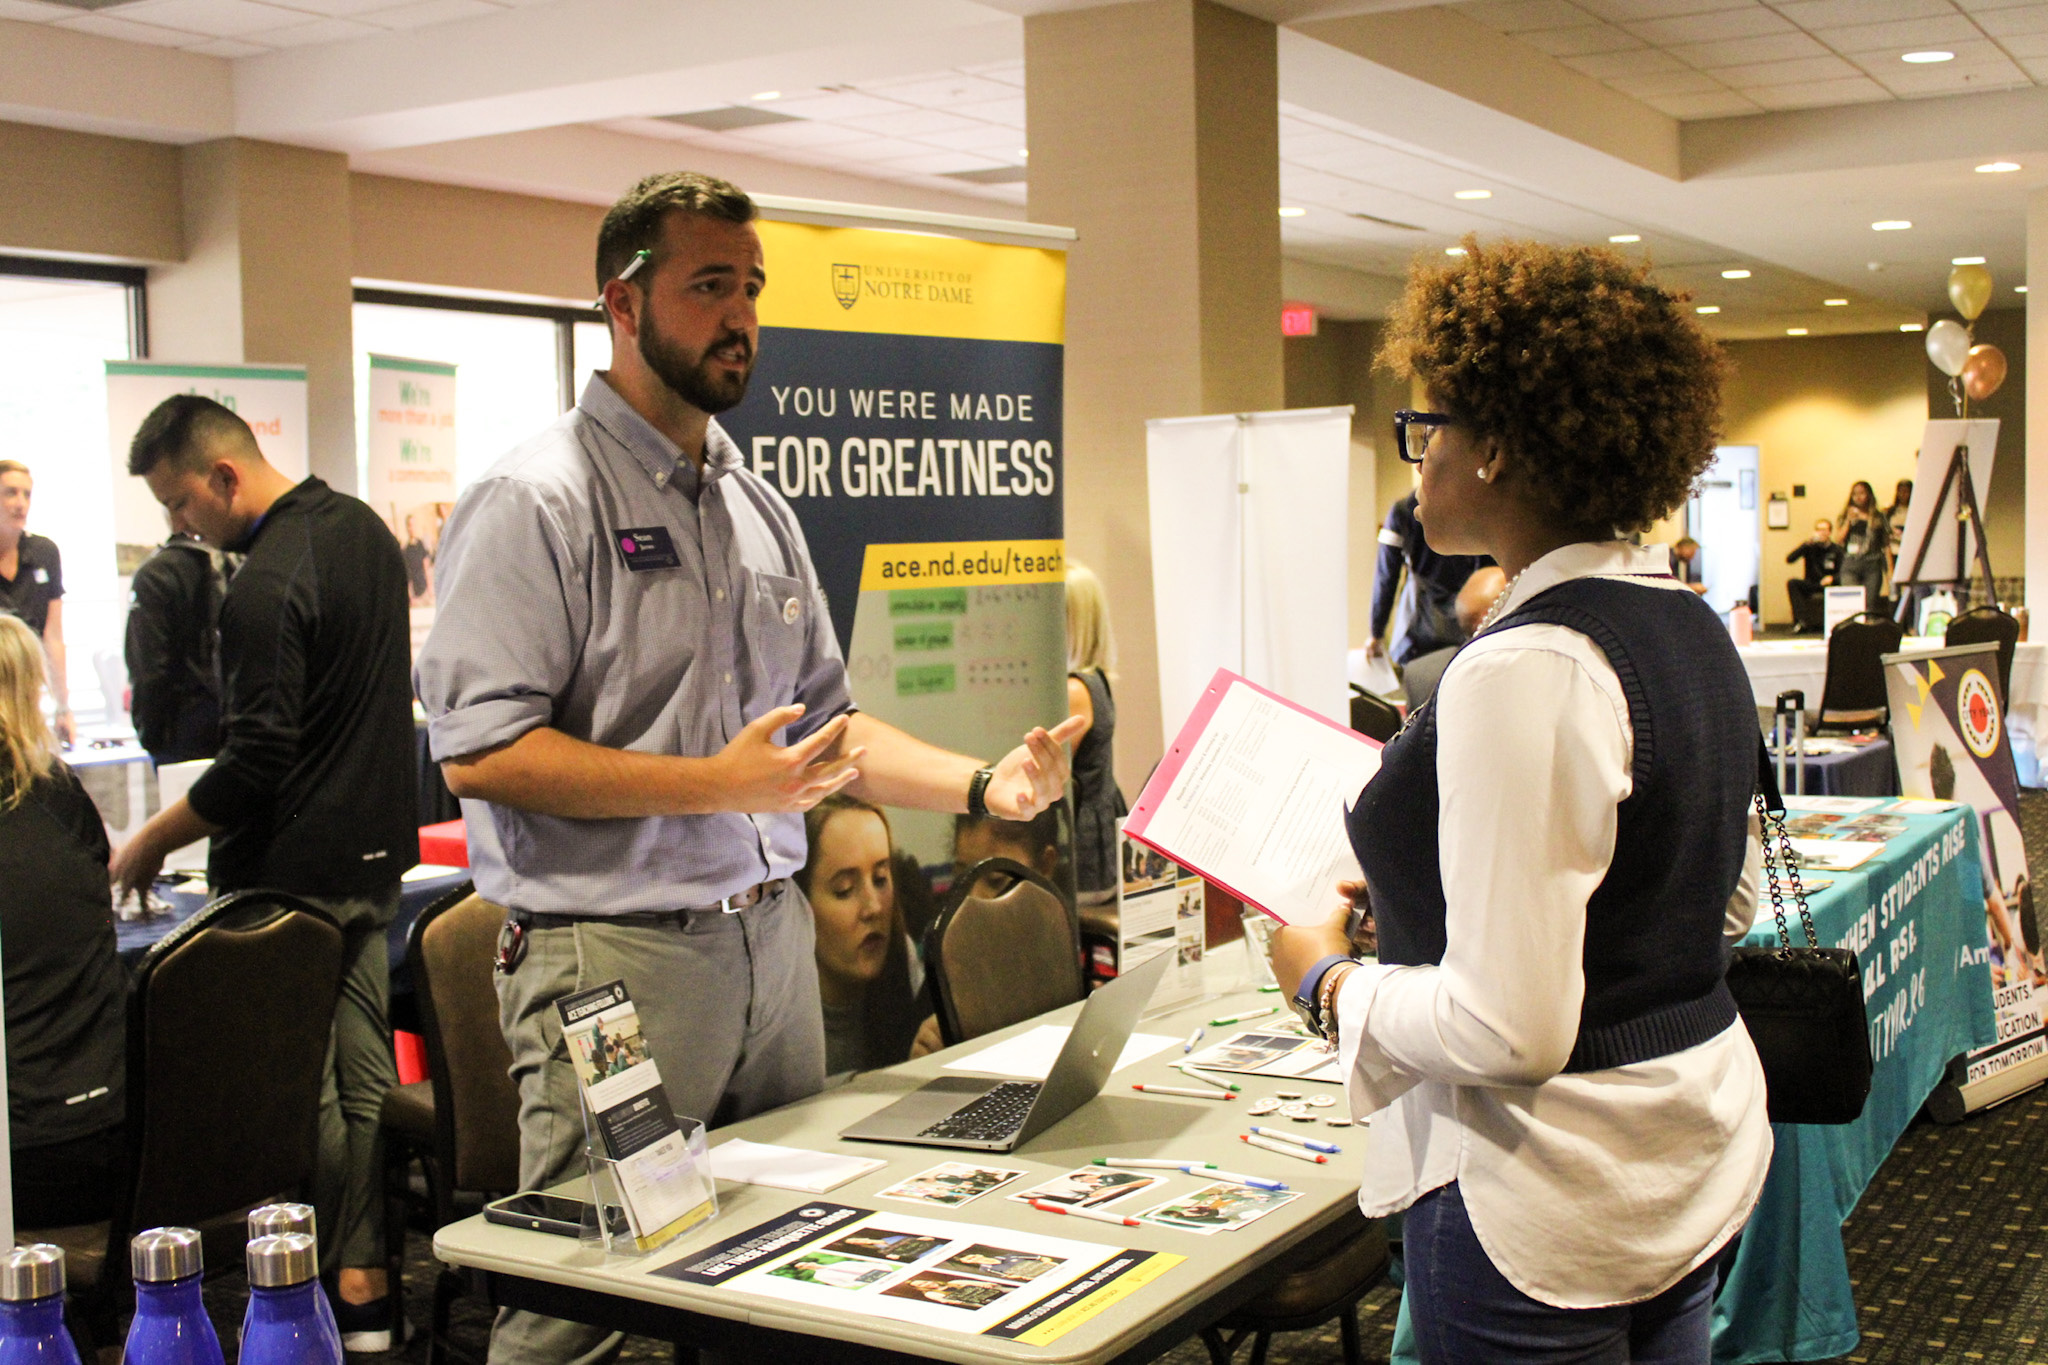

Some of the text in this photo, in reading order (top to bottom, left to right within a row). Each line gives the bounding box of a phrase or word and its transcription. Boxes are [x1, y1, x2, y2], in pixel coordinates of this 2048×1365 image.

[864, 265, 972, 284] UNIVERSITY OF
[865, 280, 973, 304] NOTRE DAME
[771, 386, 1034, 422] YOU WERE MADE
[752, 436, 1054, 497] FOR GREATNESS
[882, 548, 1062, 578] ace.nd.edu/teach
[1942, 818, 1965, 866] RISE
[1997, 1011, 2041, 1040] UCATION.
